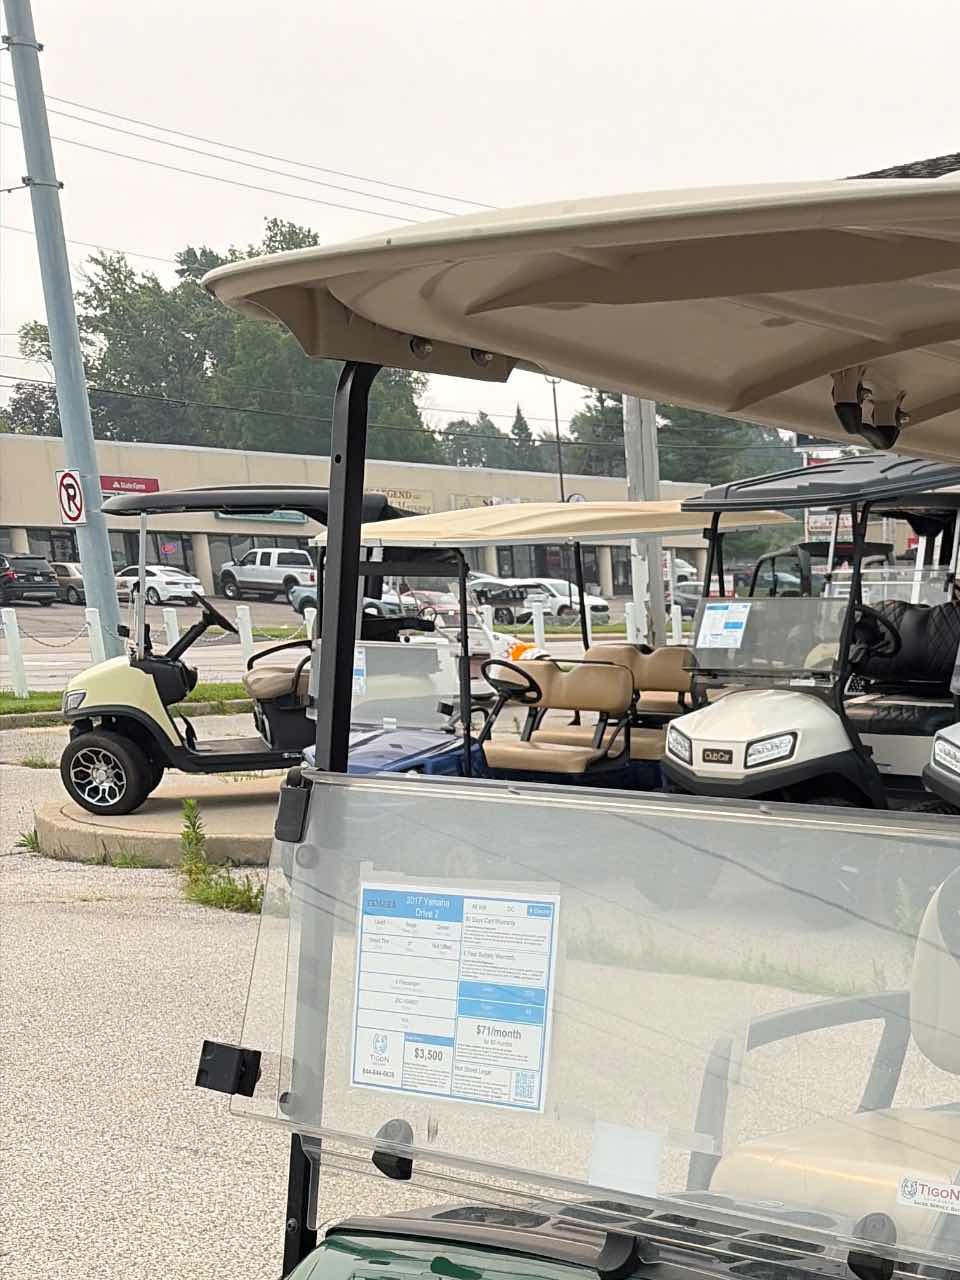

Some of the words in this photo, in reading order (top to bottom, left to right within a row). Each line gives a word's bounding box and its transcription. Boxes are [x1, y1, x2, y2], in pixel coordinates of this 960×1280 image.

[476, 1024, 522, 1039] $71/month
[414, 1048, 443, 1062] $3,500
[920, 1184, 960, 1201] TIGON
